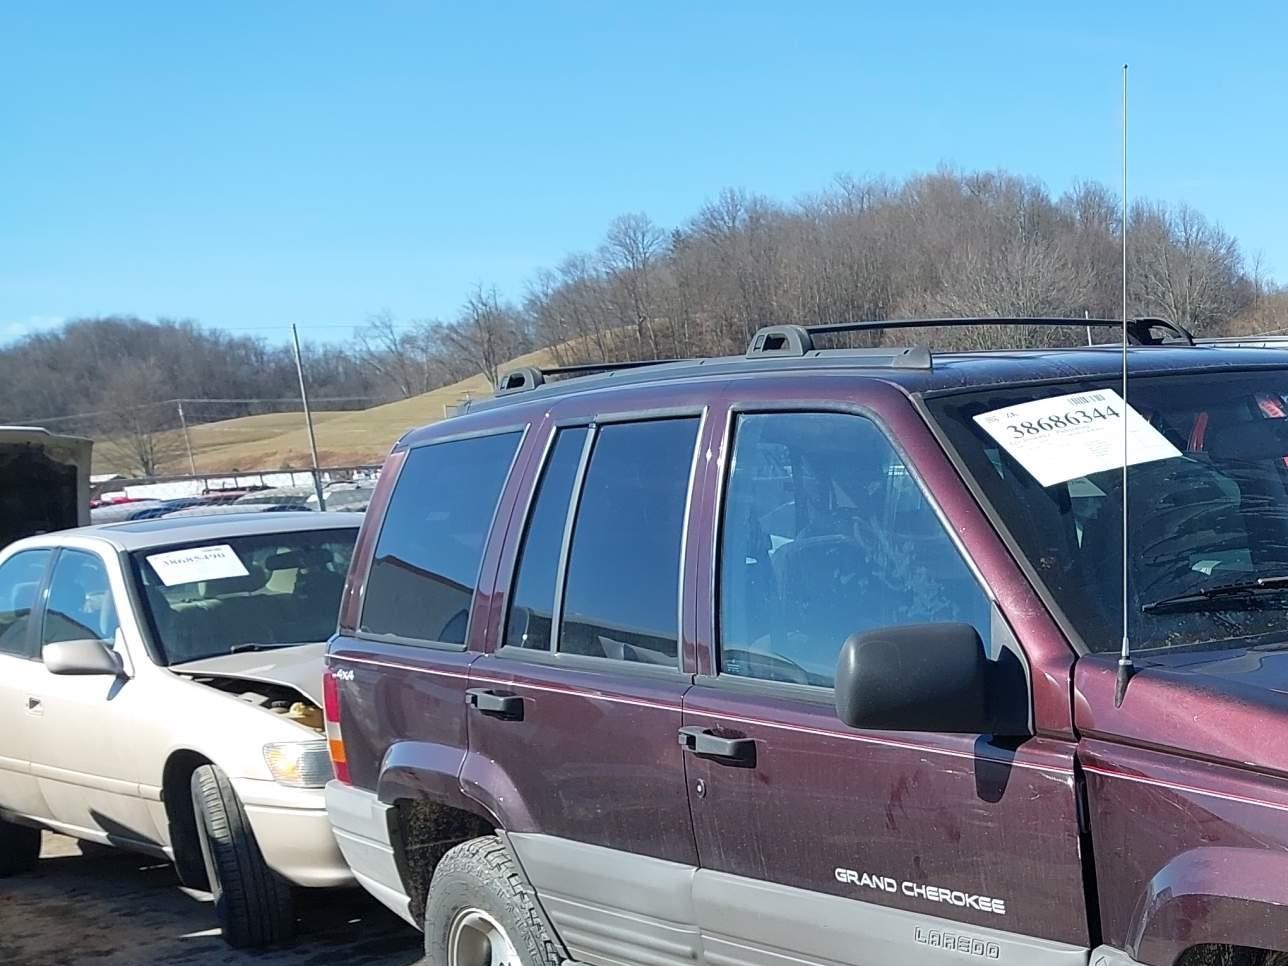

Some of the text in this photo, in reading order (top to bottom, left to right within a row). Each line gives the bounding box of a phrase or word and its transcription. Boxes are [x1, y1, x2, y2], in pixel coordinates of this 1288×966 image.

[1005, 404, 1121, 440] 38686344
[834, 867, 1006, 915] GRAND CHEROKEE
[914, 926, 1001, 960] LAREDO
